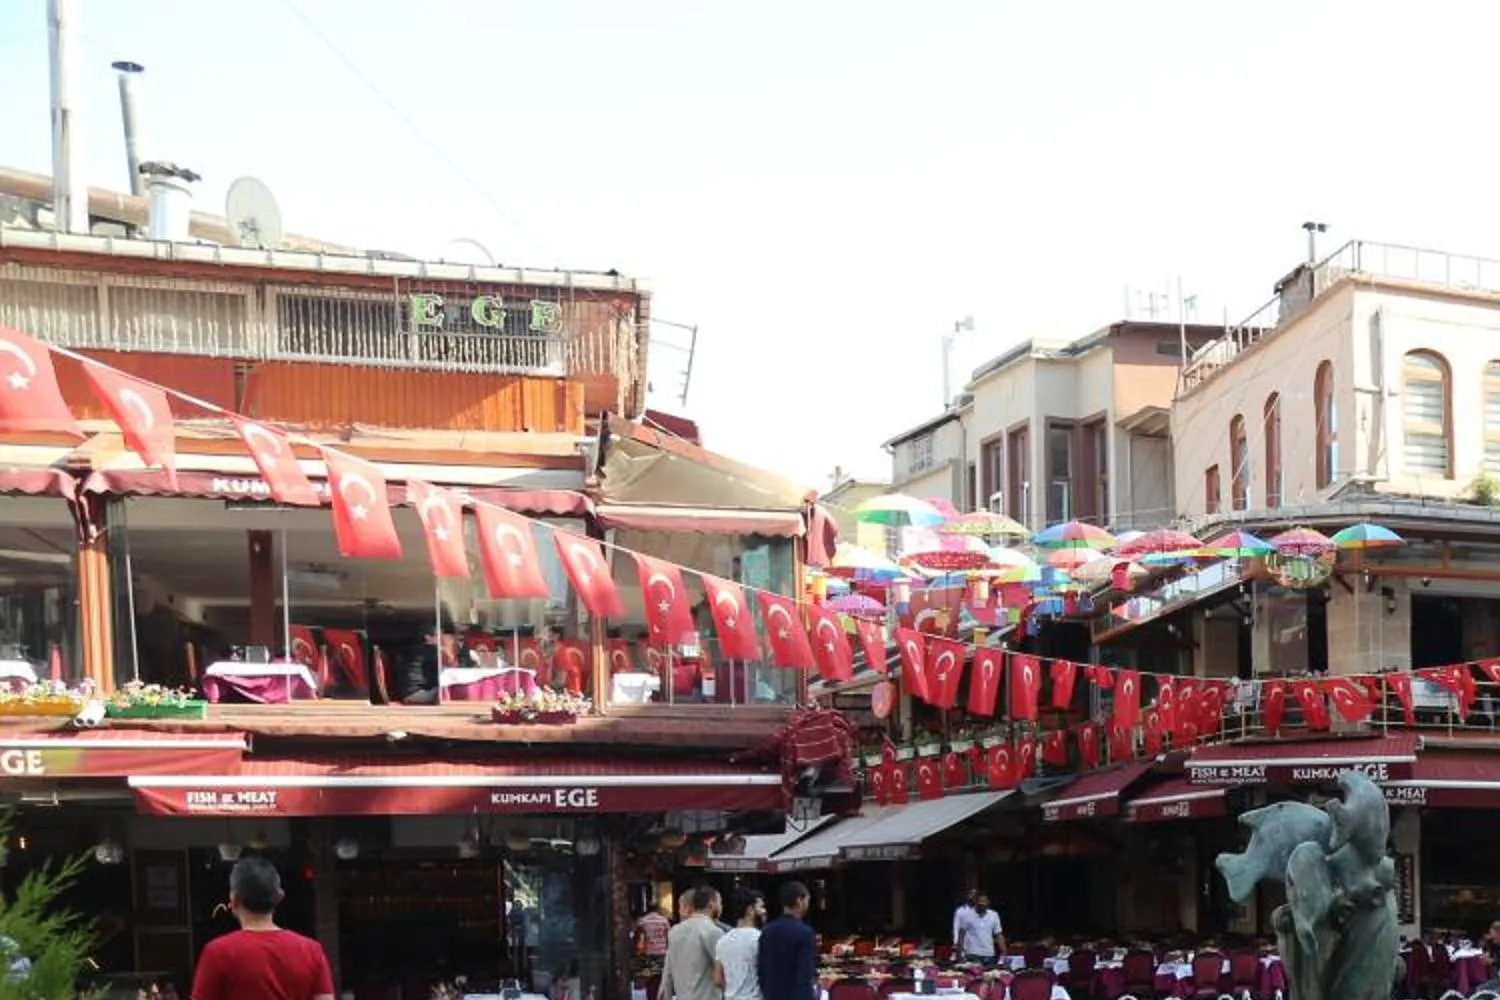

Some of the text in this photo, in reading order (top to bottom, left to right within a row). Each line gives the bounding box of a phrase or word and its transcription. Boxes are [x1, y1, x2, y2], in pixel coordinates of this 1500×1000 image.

[410, 293, 563, 333] EGE
[212, 477, 332, 497] KUMPI
[1191, 767, 1217, 779] FISH
[1231, 765, 1266, 777] MEAT
[187, 791, 218, 803] FISH
[238, 791, 277, 803] MEAT
[553, 788, 600, 808] EGE
[1396, 787, 1427, 799] MEAT
